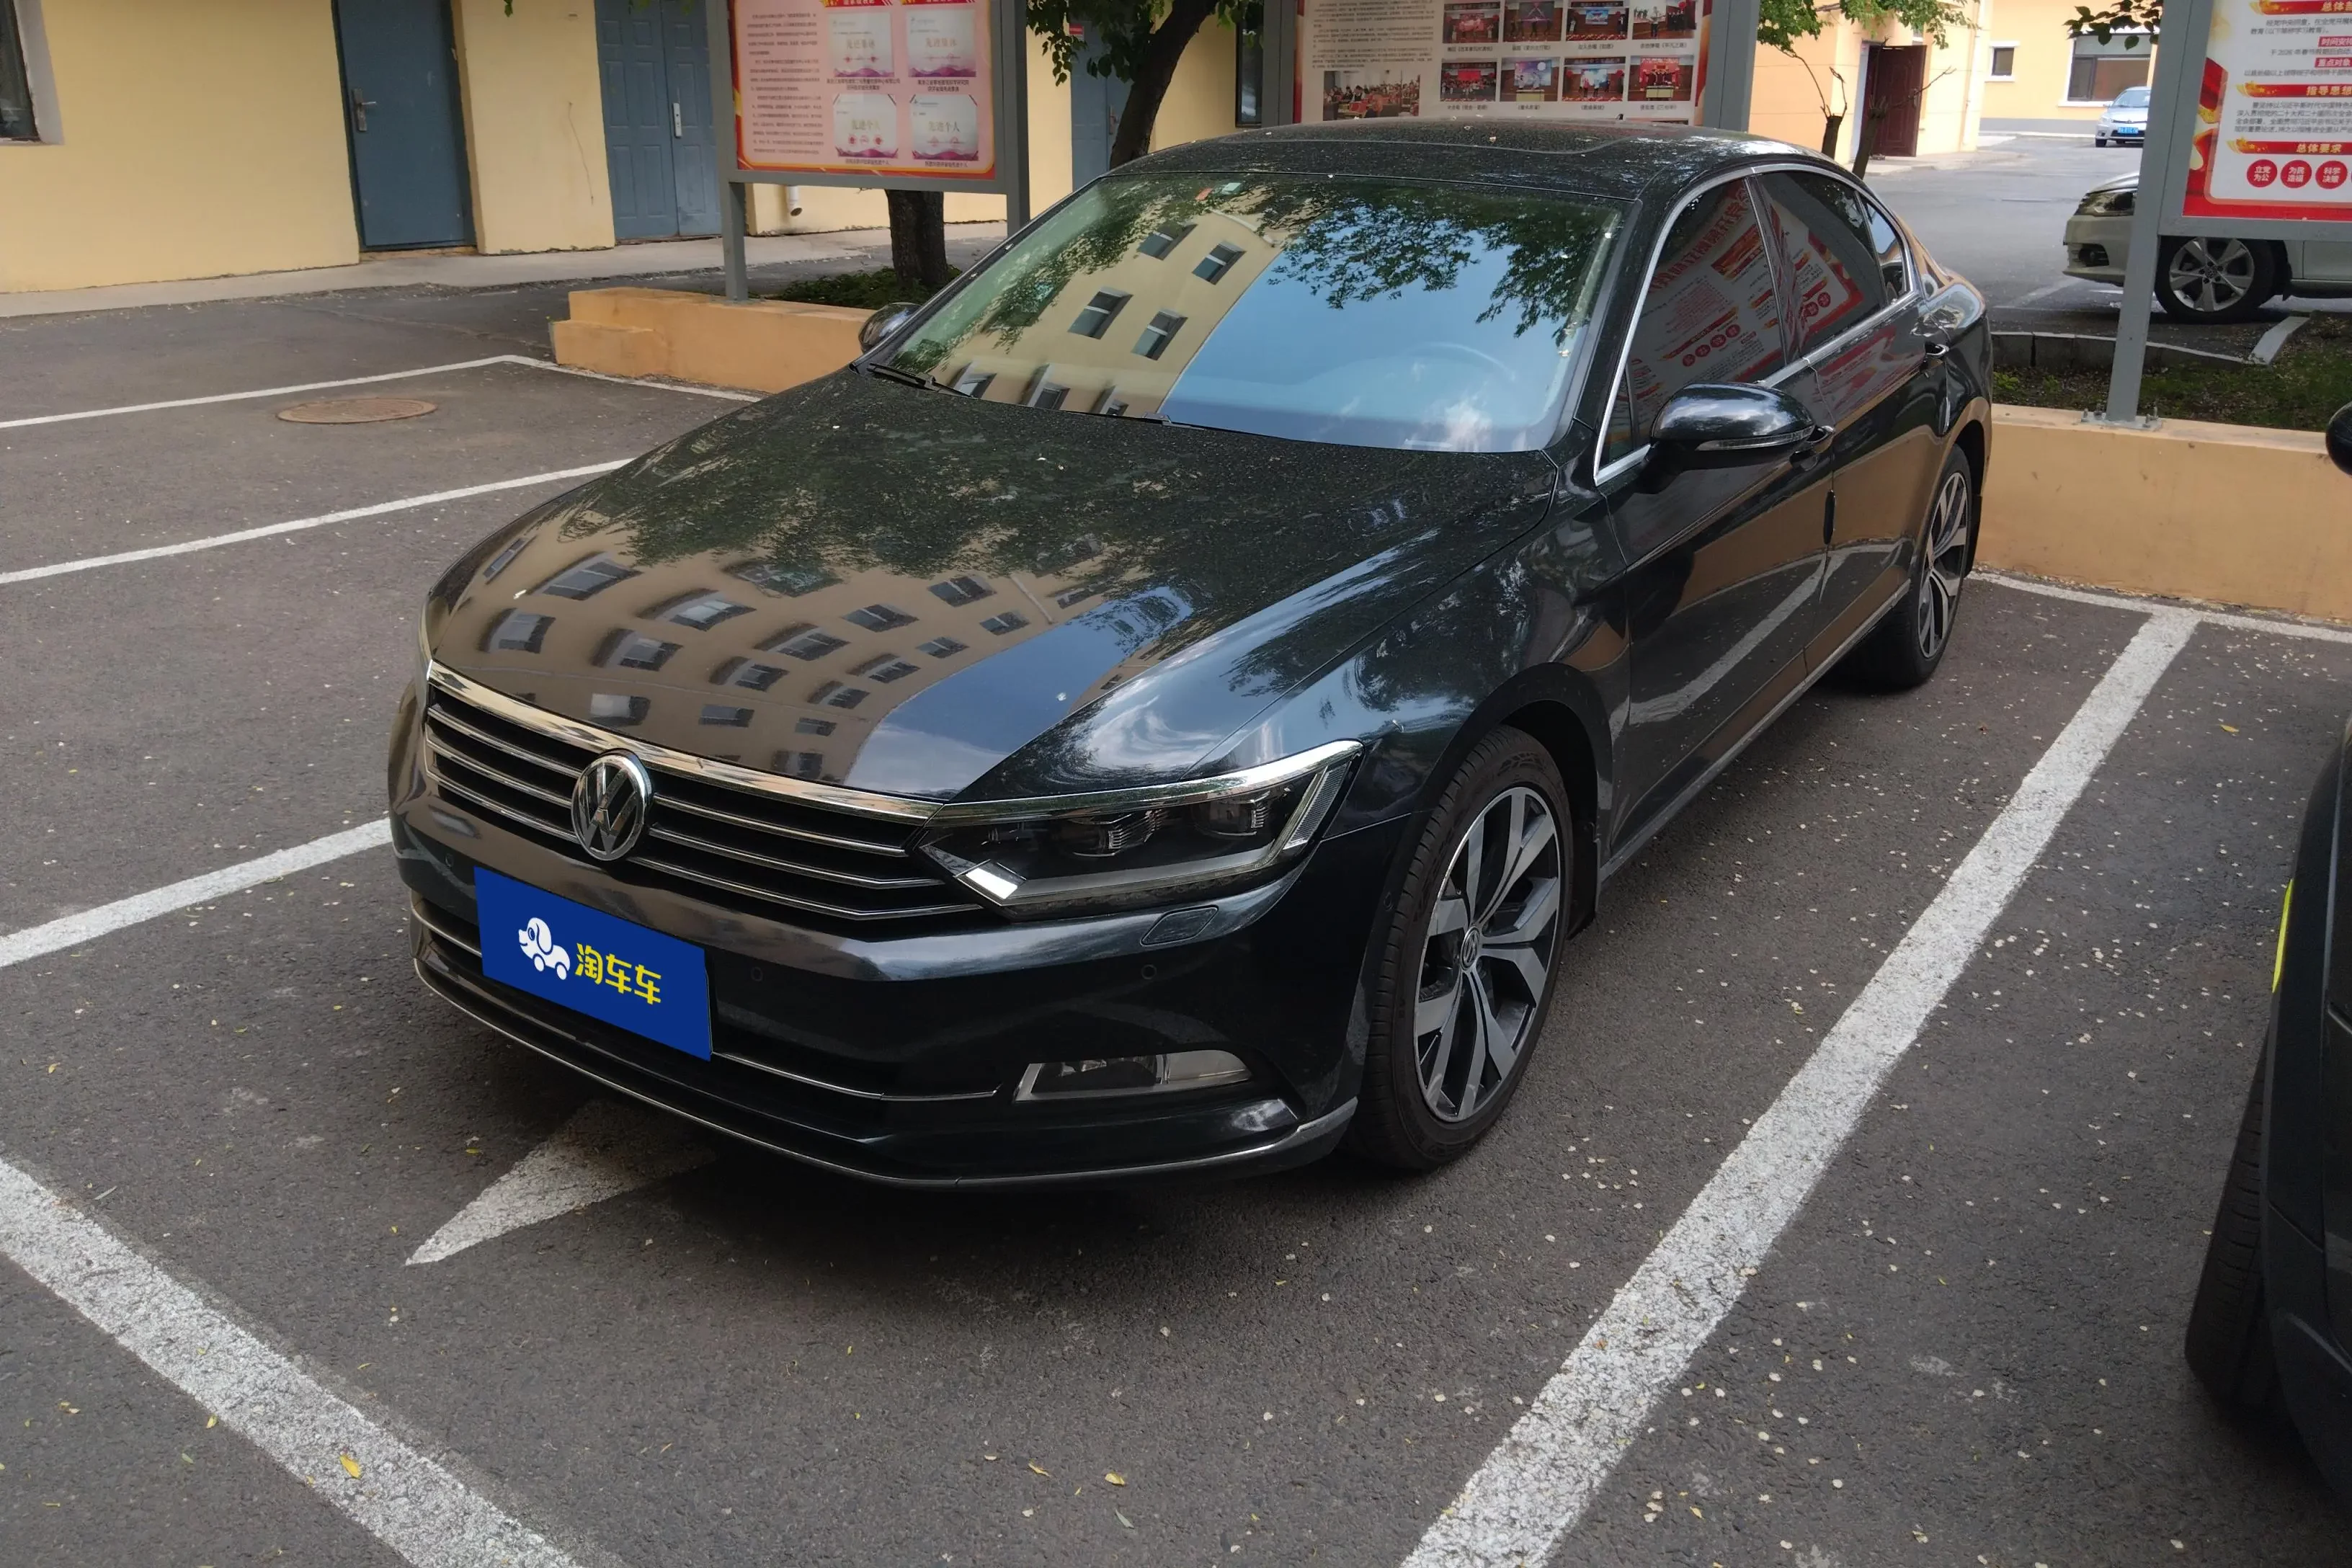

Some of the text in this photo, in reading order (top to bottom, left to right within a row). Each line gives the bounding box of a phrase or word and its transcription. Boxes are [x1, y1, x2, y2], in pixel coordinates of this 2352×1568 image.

[2306, 86, 2352, 96] 指导思想
[2297, 143, 2342, 153] 总体要求
